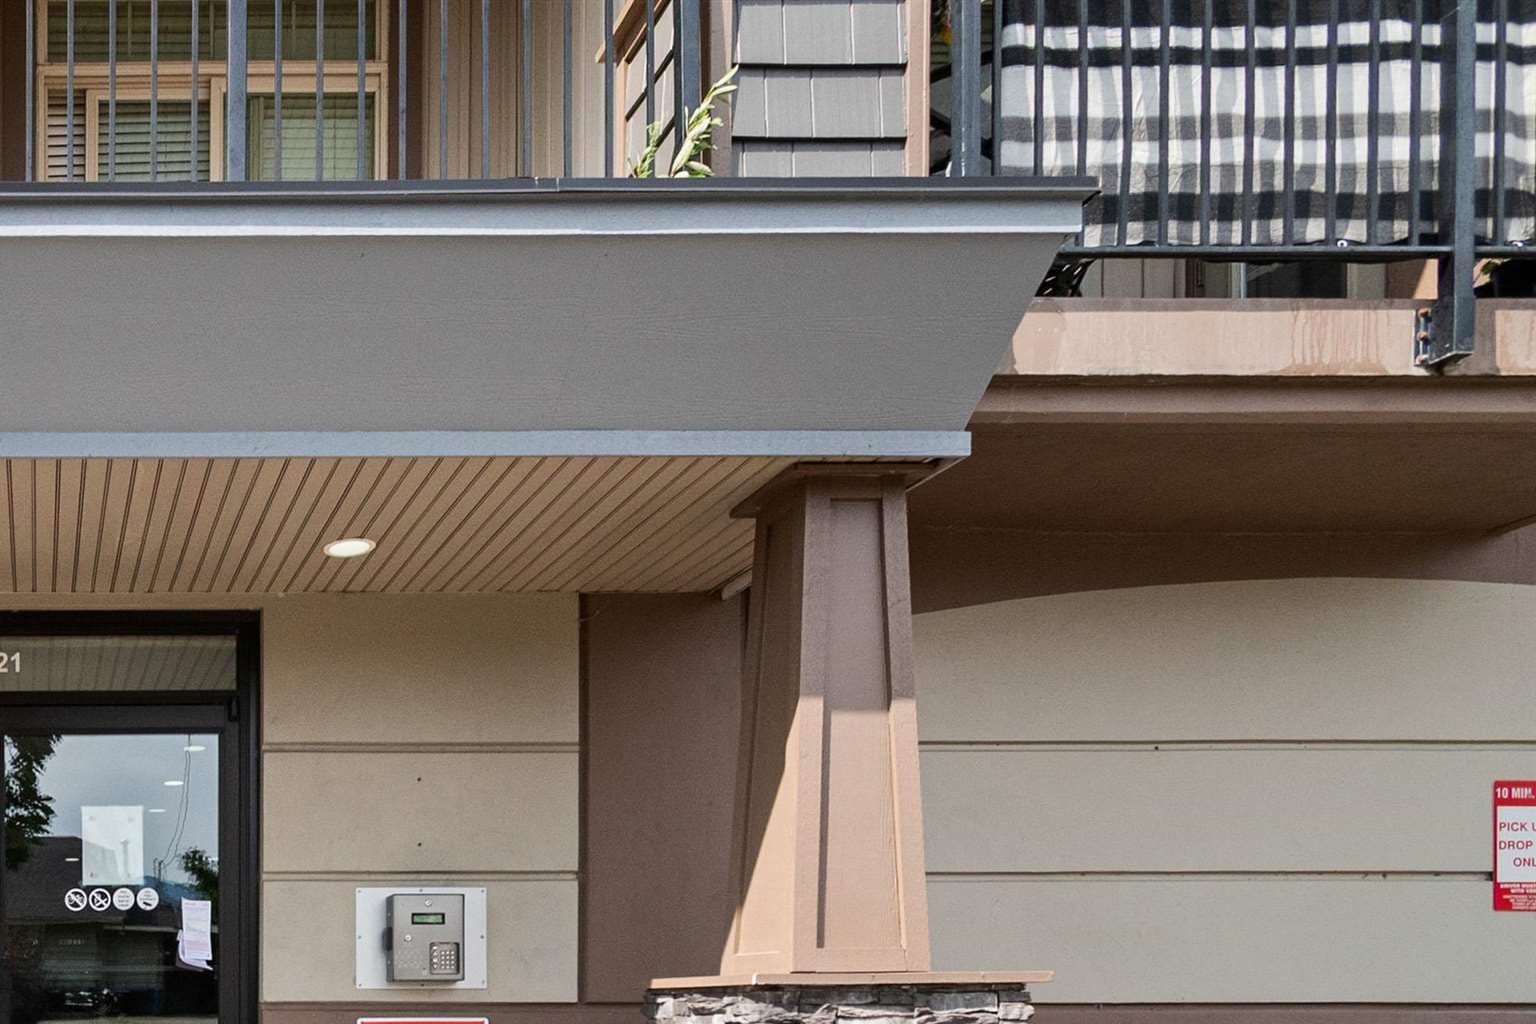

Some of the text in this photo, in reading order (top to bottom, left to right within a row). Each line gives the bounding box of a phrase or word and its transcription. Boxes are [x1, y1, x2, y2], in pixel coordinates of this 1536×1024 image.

[1495, 787, 1509, 799] 10
[1498, 821, 1528, 832] PICK
[1498, 840, 1533, 851] DROP
[1512, 857, 1536, 868] ONL
